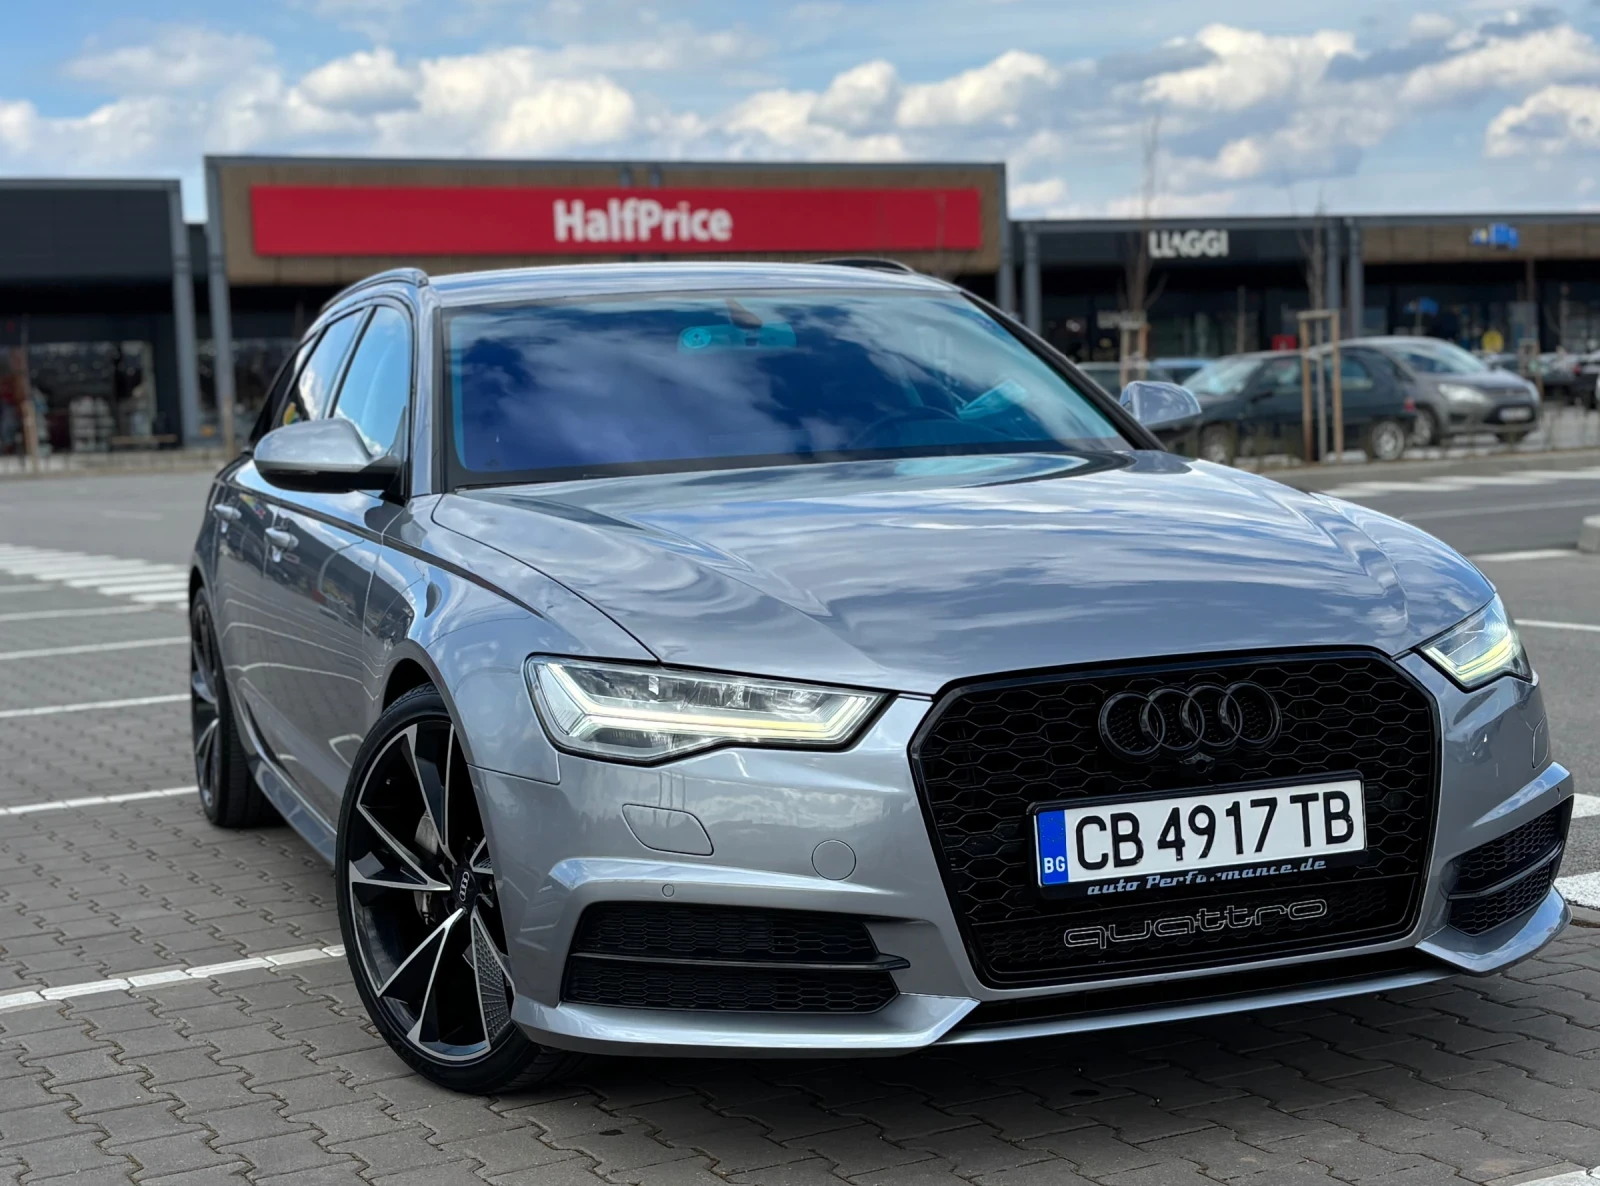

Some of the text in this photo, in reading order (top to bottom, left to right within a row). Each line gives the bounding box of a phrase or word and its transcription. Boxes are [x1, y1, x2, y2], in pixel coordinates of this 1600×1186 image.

[553, 197, 733, 242] HalfPrice
[1075, 790, 1355, 871] CB 4917 TB
[1043, 855, 1066, 874] BG
[1087, 879, 1141, 895] auto
[1063, 899, 1328, 949] quattro
